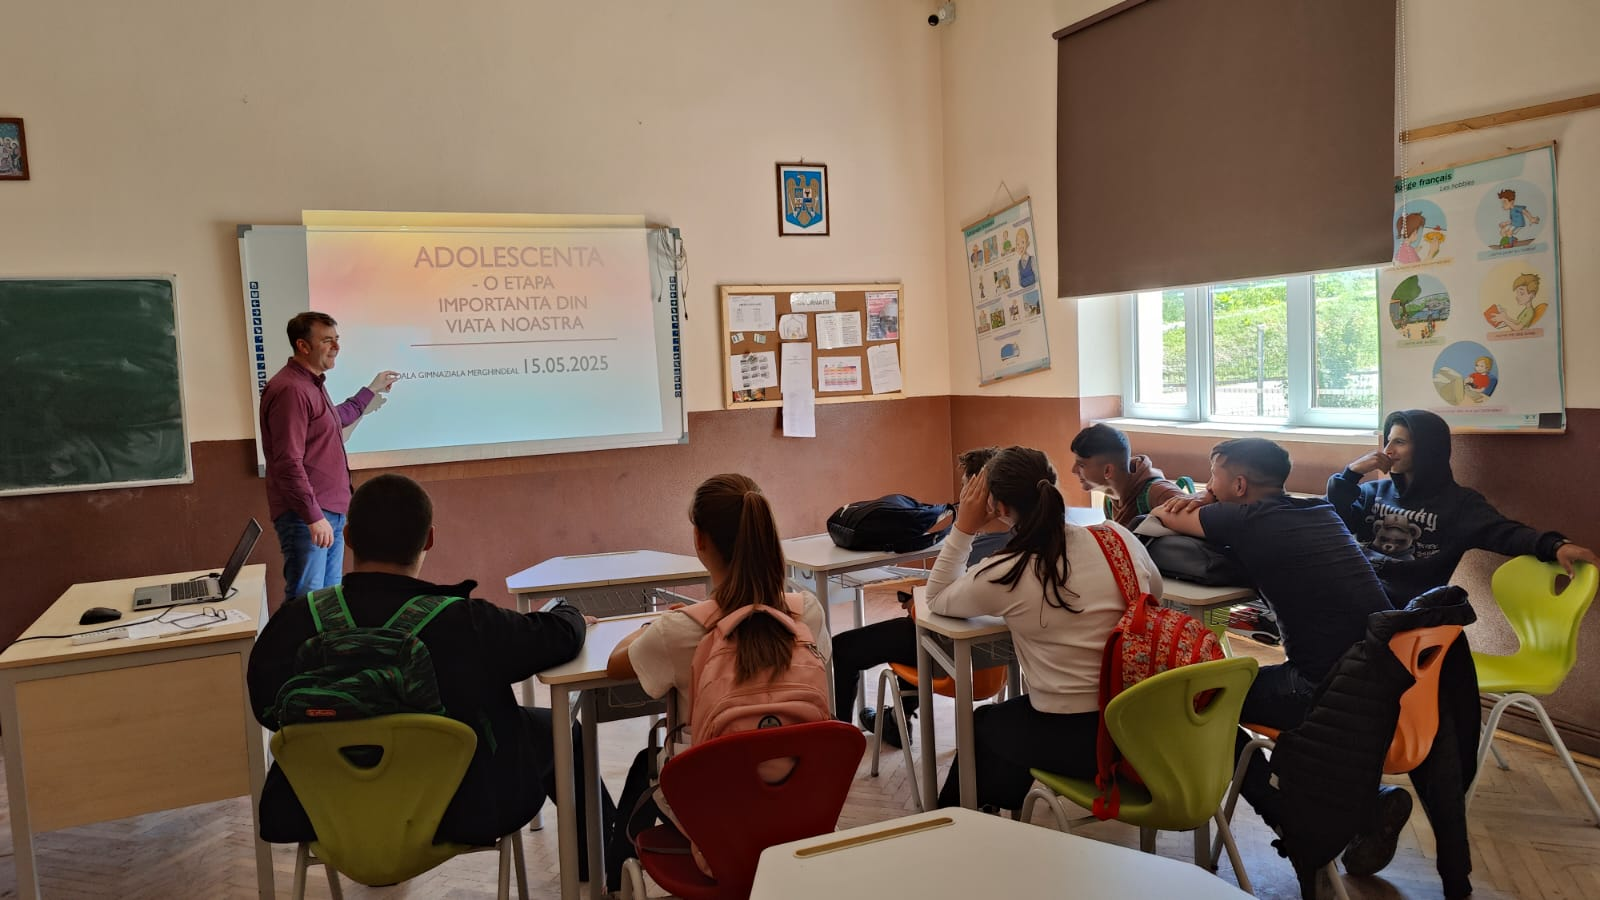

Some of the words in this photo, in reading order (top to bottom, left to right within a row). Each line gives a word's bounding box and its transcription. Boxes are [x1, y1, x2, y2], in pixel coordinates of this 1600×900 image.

[1419, 172, 1453, 187] français
[414, 246, 605, 269] ADOLESCENTA
[484, 275, 498, 291] O
[505, 275, 555, 291] ETAPA
[439, 297, 551, 313] IMPORTANTA
[557, 295, 588, 310] DIN
[446, 318, 496, 334] VIATA
[502, 315, 584, 332] NOASTRA
[418, 368, 466, 379] GIMNAZIALA
[467, 366, 520, 377] MERGHINDEAL
[524, 355, 609, 375] 15.05.2025
